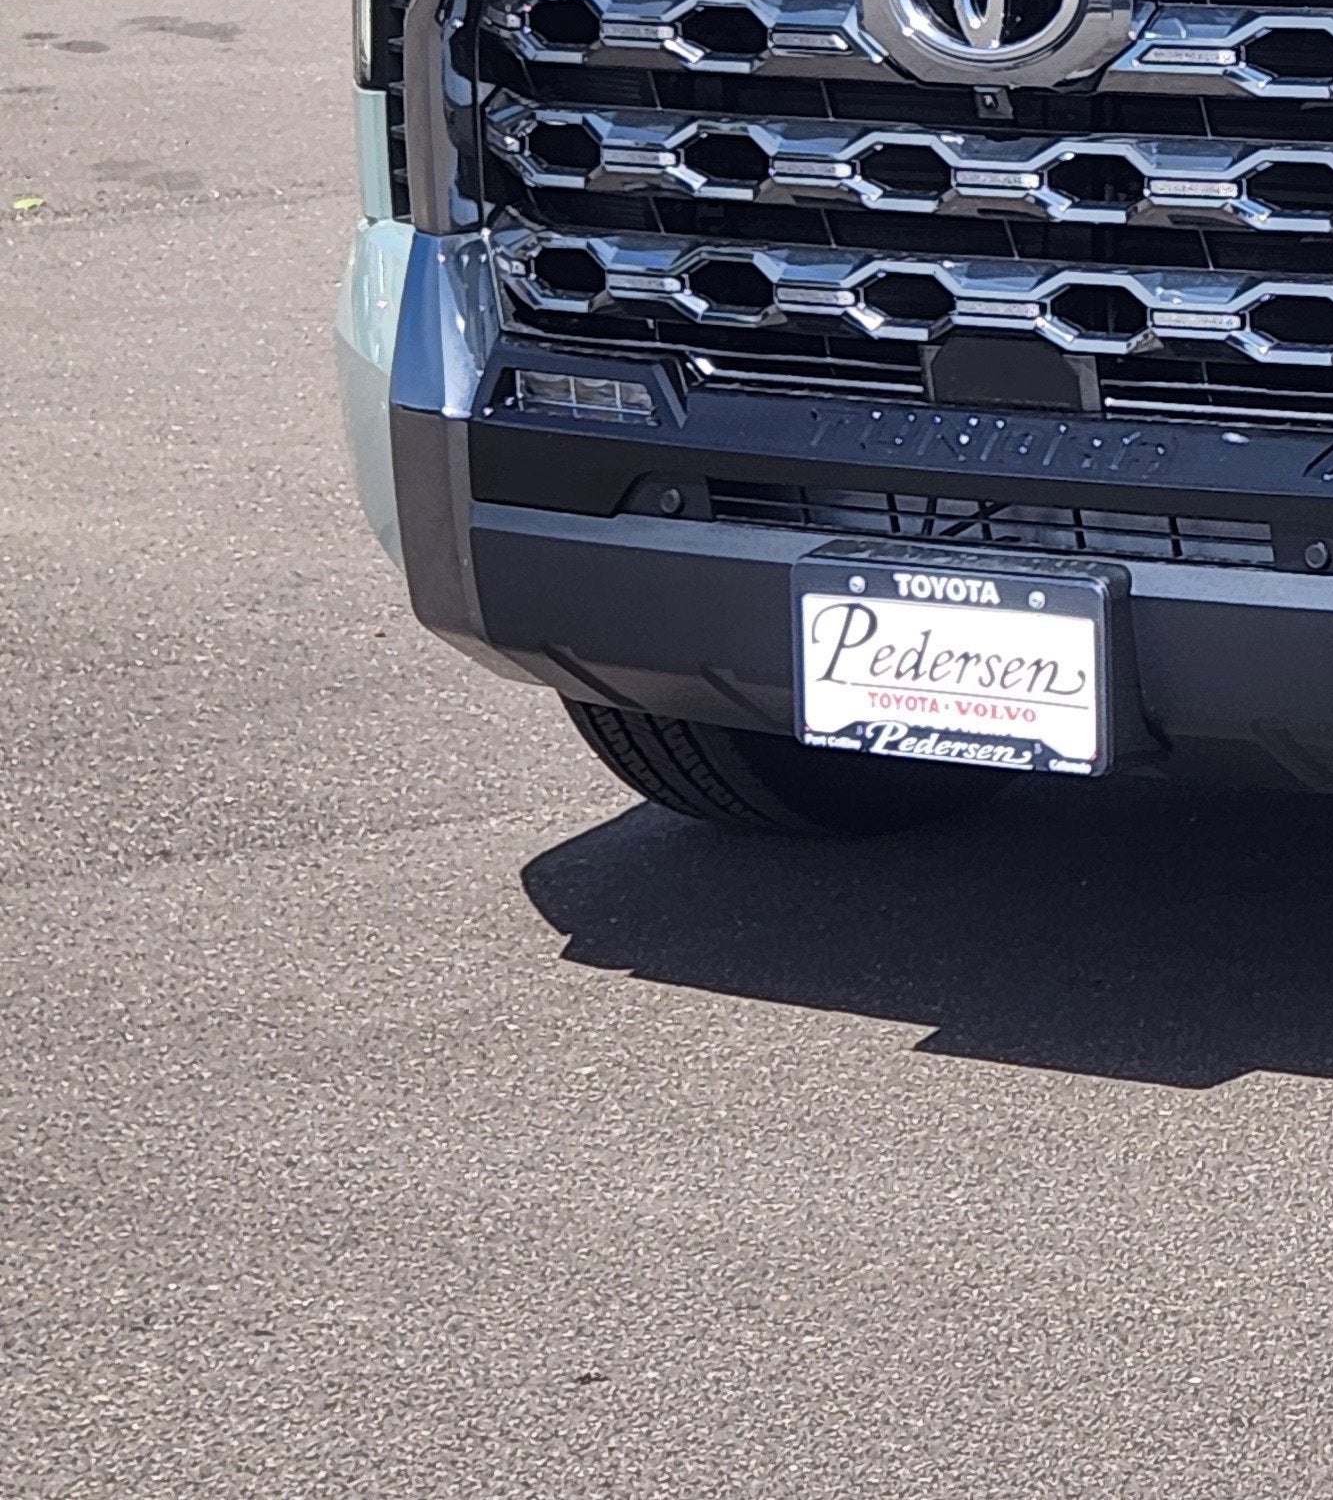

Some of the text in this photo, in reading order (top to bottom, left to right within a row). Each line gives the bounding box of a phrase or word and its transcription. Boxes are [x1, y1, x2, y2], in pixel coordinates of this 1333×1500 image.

[892, 572, 1001, 606] TOYOTA
[811, 602, 1087, 696] Pedersen
[867, 691, 1038, 723] TOYOTA VOLVO
[865, 720, 1033, 764] Pedersen
